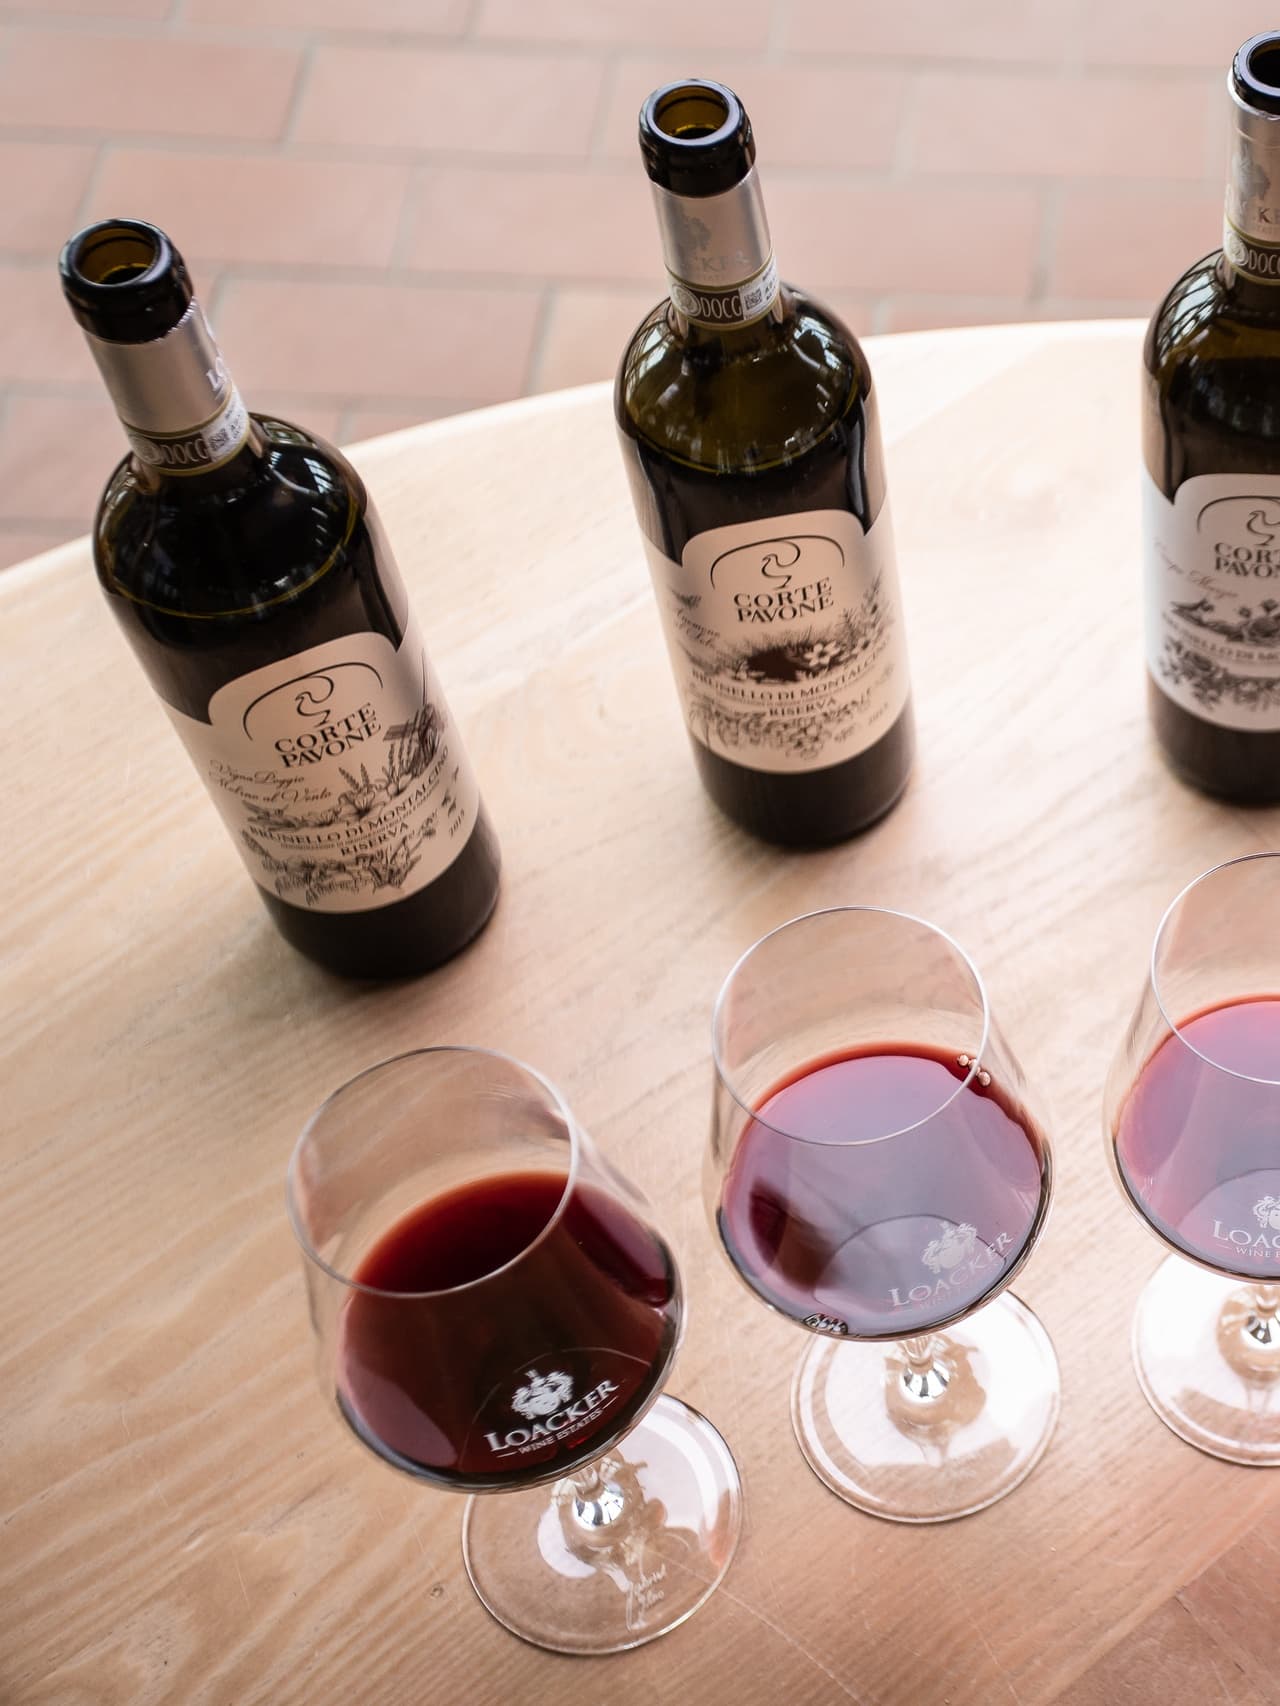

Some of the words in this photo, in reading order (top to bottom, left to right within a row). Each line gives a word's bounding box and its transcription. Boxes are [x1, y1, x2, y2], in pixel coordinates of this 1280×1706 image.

[733, 576, 833, 608] CORTE
[737, 593, 834, 623] PAVONE
[274, 701, 378, 753] CORTE
[281, 721, 382, 768] PAVONE
[249, 824, 341, 845] BRUNELLO
[344, 824, 364, 838] DI
[340, 822, 409, 857] RISERVA
[888, 1231, 1014, 1307] LOACKER
[1235, 1246, 1271, 1258] WINE
[483, 1379, 620, 1452] LOACKER
[517, 1436, 555, 1454] WINE
[557, 1408, 604, 1441] ESTATES
